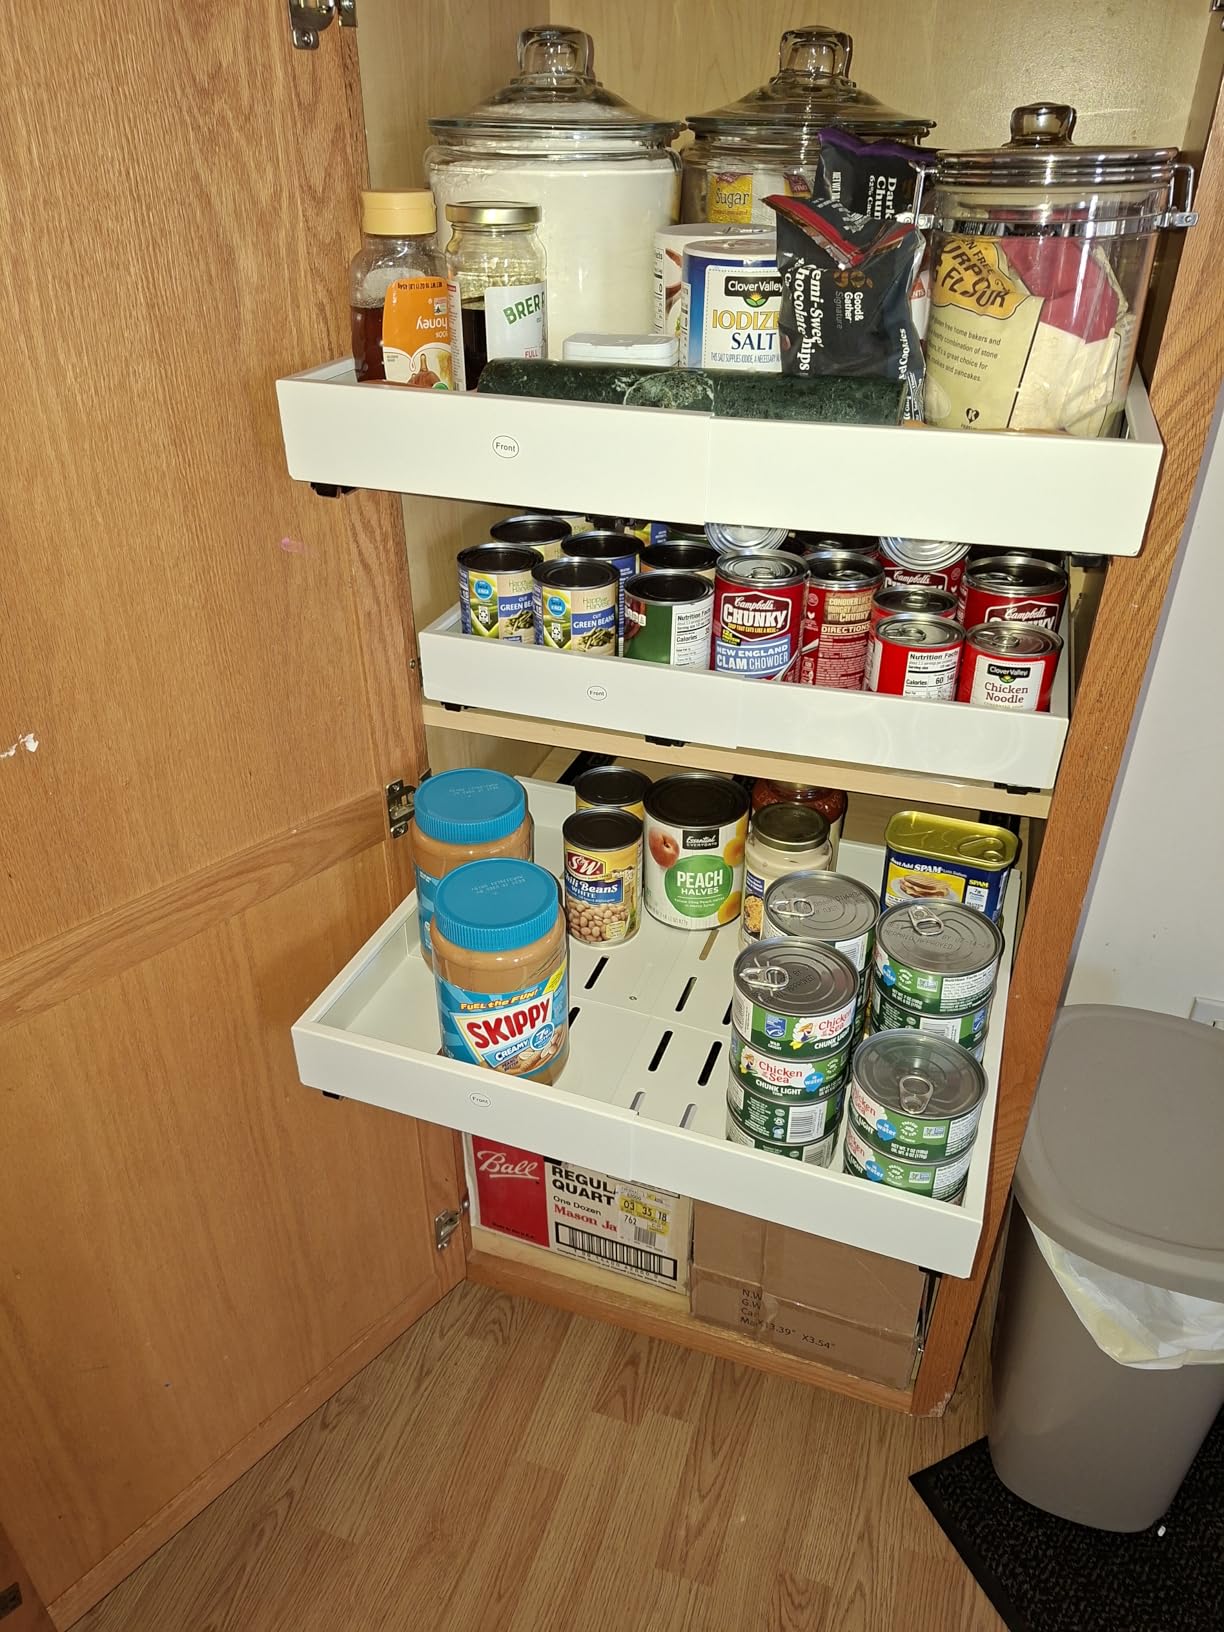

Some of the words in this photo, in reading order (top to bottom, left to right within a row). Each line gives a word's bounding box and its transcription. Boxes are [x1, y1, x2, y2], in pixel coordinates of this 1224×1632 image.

[716, 188, 750, 208] Sugar
[874, 176, 886, 220] Chun
[885, 177, 897, 220] Dark
[728, 281, 758, 292] Clover
[758, 282, 784, 294] Valley
[503, 294, 540, 324] BRER
[834, 291, 844, 328] Signature
[844, 292, 854, 321] Gather
[416, 315, 448, 330] honey
[712, 309, 781, 331] IODIZE
[731, 332, 776, 350] SALT
[968, 332, 988, 343] bakers
[988, 338, 1002, 346] and
[797, 336, 816, 371] hips
[980, 350, 998, 360] stone
[960, 356, 978, 368] choice
[979, 362, 988, 370] for
[496, 442, 516, 452] Front
[500, 602, 523, 611] GREEN
[734, 596, 776, 610] Campbell's
[573, 620, 597, 628] GREEN
[598, 614, 614, 626] BEANS
[678, 613, 700, 622] Nutrition
[702, 607, 711, 616] Fact
[723, 604, 788, 628] CHUNKY
[840, 610, 870, 622] CHUNKY
[1004, 606, 1047, 621] Campbell's
[822, 624, 870, 634] DIRECTIONS
[676, 634, 698, 642] Calories
[716, 646, 736, 656] NEW
[738, 644, 788, 658] ENGLAND
[716, 654, 748, 670] CLAM
[749, 652, 789, 670] CHOWDER
[990, 666, 1010, 674] Clover
[1010, 668, 1028, 678] Valley
[935, 676, 944, 684] 60
[984, 682, 1028, 694] Chicken
[986, 692, 1024, 704] Noodle
[686, 835, 716, 844] Essential
[569, 856, 600, 875] S&W
[914, 864, 942, 874] SPAM
[566, 874, 579, 888] hili
[580, 881, 618, 894] Beans
[676, 870, 723, 888] PEACH
[968, 879, 990, 888] SPAM
[571, 886, 596, 898] WHITE
[681, 886, 719, 896] HALVES
[460, 1002, 487, 1011] FUEL
[488, 999, 510, 1008] the
[510, 989, 538, 1004] FUN!
[466, 998, 550, 1049] SKIPPY
[818, 1008, 852, 1030] Chicken
[828, 1024, 844, 1036] Sea
[495, 1039, 530, 1062] CREAMY
[814, 1037, 837, 1050] CHUNK
[759, 1060, 803, 1078] Chicken
[768, 1073, 790, 1084] Sea
[804, 1076, 824, 1086] water
[756, 1078, 780, 1093] CHUNK
[780, 1088, 802, 1096] LIGHT
[877, 1124, 896, 1137] water
[477, 1150, 540, 1180] Ball
[866, 1166, 884, 1178] water
[552, 1165, 617, 1196] REGUL
[552, 1178, 615, 1206] QUART
[553, 1195, 571, 1206] One
[573, 1201, 602, 1216] Dozen
[624, 1200, 634, 1211] 03
[642, 1206, 652, 1217] 35
[658, 1211, 668, 1222] 18
[554, 1204, 598, 1226] Mason
[602, 1220, 618, 1233] Ja
[624, 1214, 637, 1226] 762
